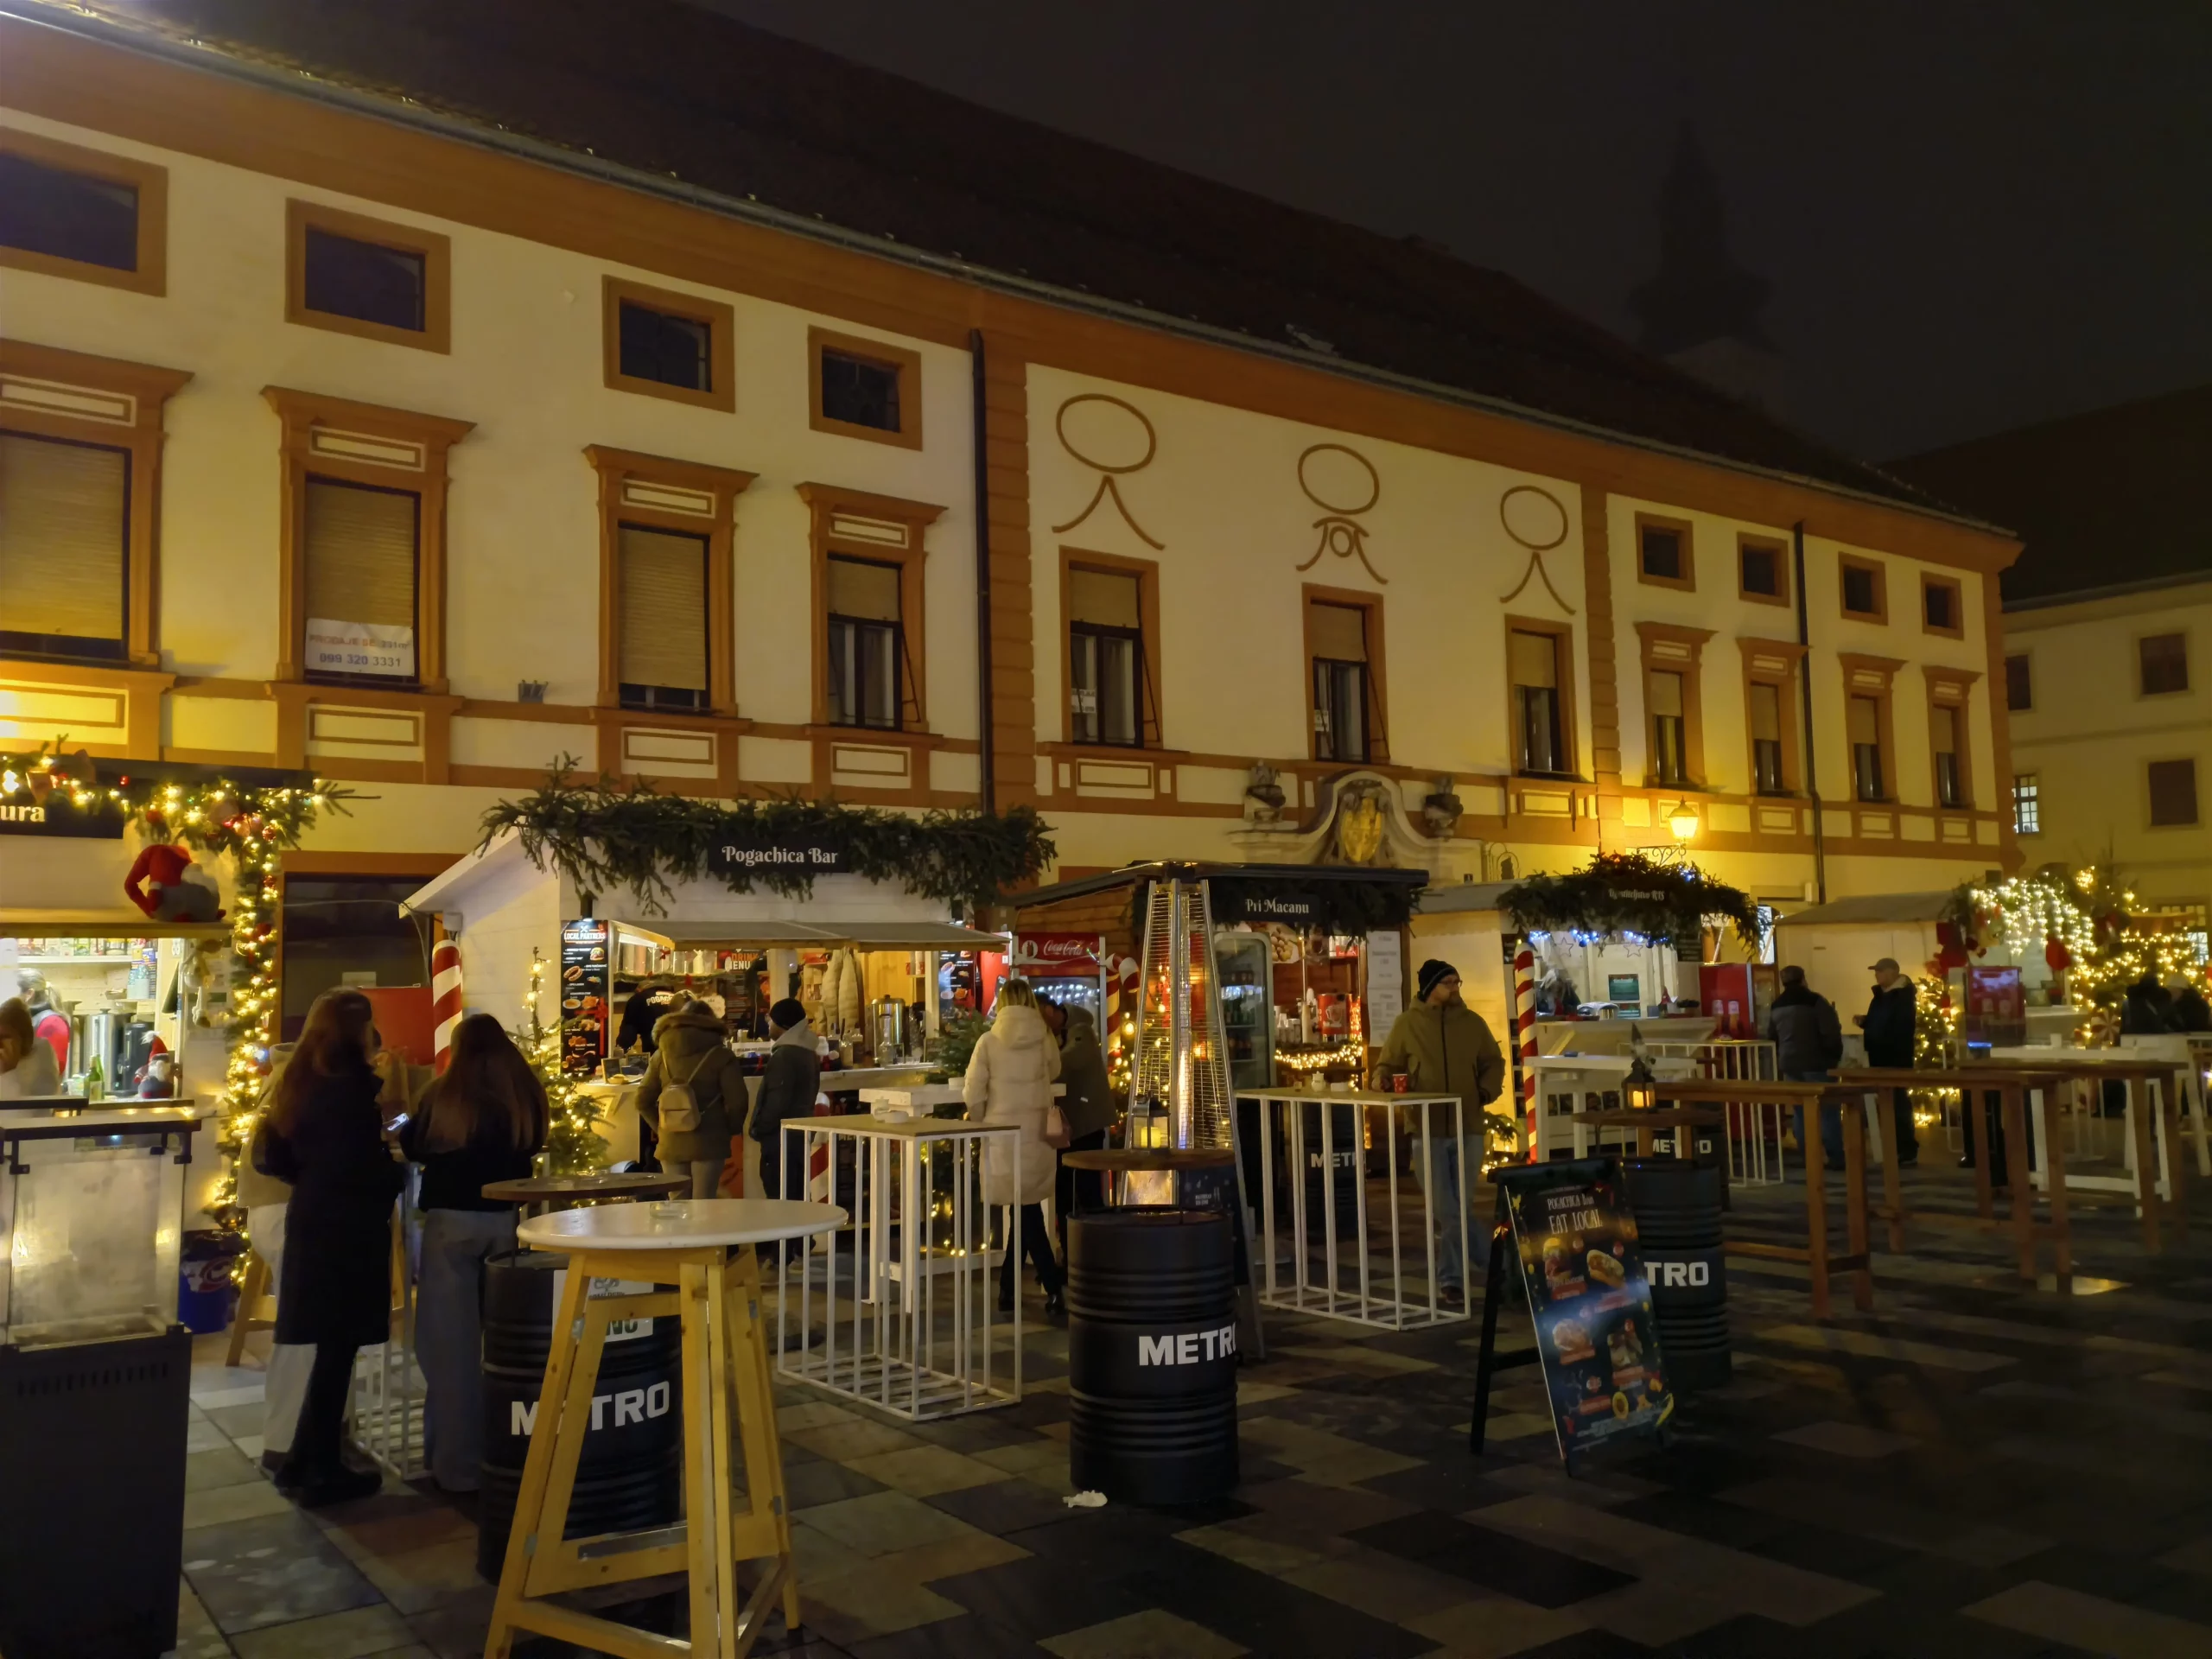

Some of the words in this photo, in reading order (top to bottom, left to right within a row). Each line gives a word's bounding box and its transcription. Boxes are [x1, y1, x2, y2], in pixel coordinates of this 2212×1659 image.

[308, 634, 359, 645] PRODAJE
[362, 638, 376, 647] SE
[320, 652, 342, 664] 099
[346, 653, 368, 665] 320
[372, 656, 401, 667] 3331
[721, 845, 804, 867] Pogachica
[808, 847, 838, 863] Bar
[1245, 899, 1262, 912] Pri
[1263, 896, 1310, 914] Macanu
[731, 952, 759, 962] DRINK
[1548, 1213, 1568, 1235] EAT
[1572, 1208, 1603, 1231] LOCAL
[1643, 1261, 1709, 1287] TRO
[511, 1380, 671, 1436] MTRO
